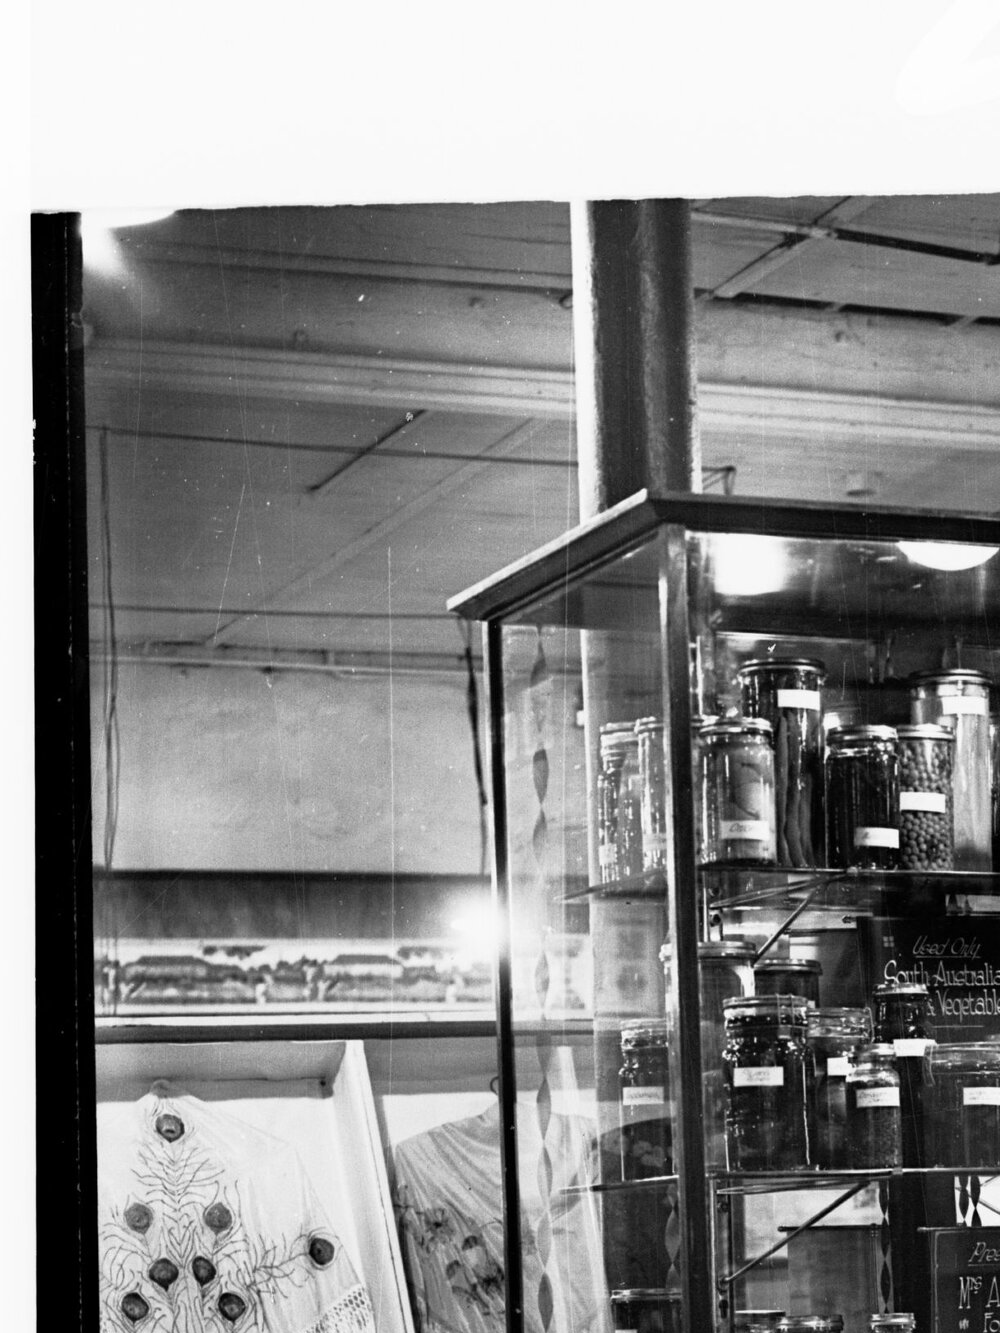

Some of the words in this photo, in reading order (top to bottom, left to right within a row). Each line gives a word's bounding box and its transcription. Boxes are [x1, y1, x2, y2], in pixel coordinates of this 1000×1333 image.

[912, 935, 950, 955] Used
[951, 936, 982, 960] Only
[884, 960, 930, 986] South
